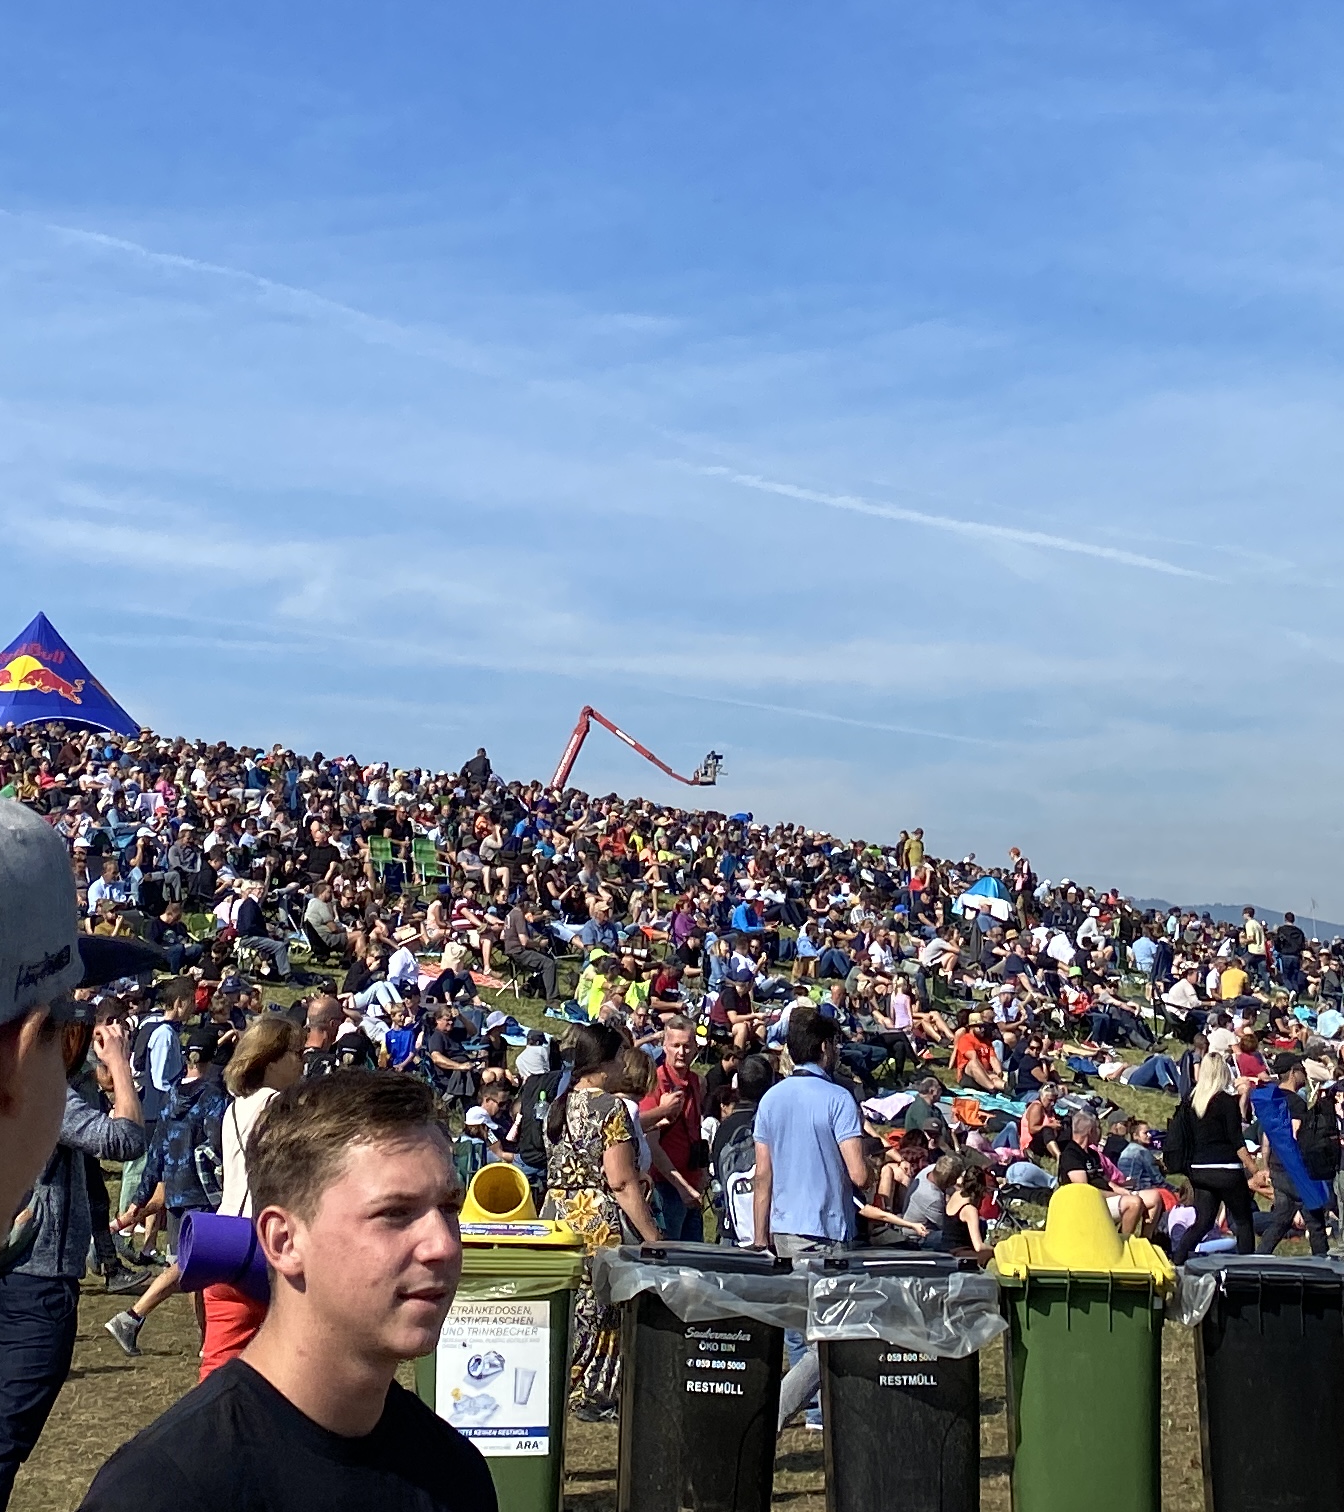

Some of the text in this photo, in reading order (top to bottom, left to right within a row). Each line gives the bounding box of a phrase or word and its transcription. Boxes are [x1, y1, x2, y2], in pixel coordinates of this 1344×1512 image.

[450, 1304, 533, 1316] ETRÄNKEDOSEN,
[447, 1316, 535, 1326] LASTIKFLASCHEN
[442, 1327, 539, 1337] UND TRINKBECHER
[879, 1373, 938, 1386] RESTMÜLL
[686, 1380, 744, 1395] RESTMÜLL
[515, 1440, 539, 1450] ARA
